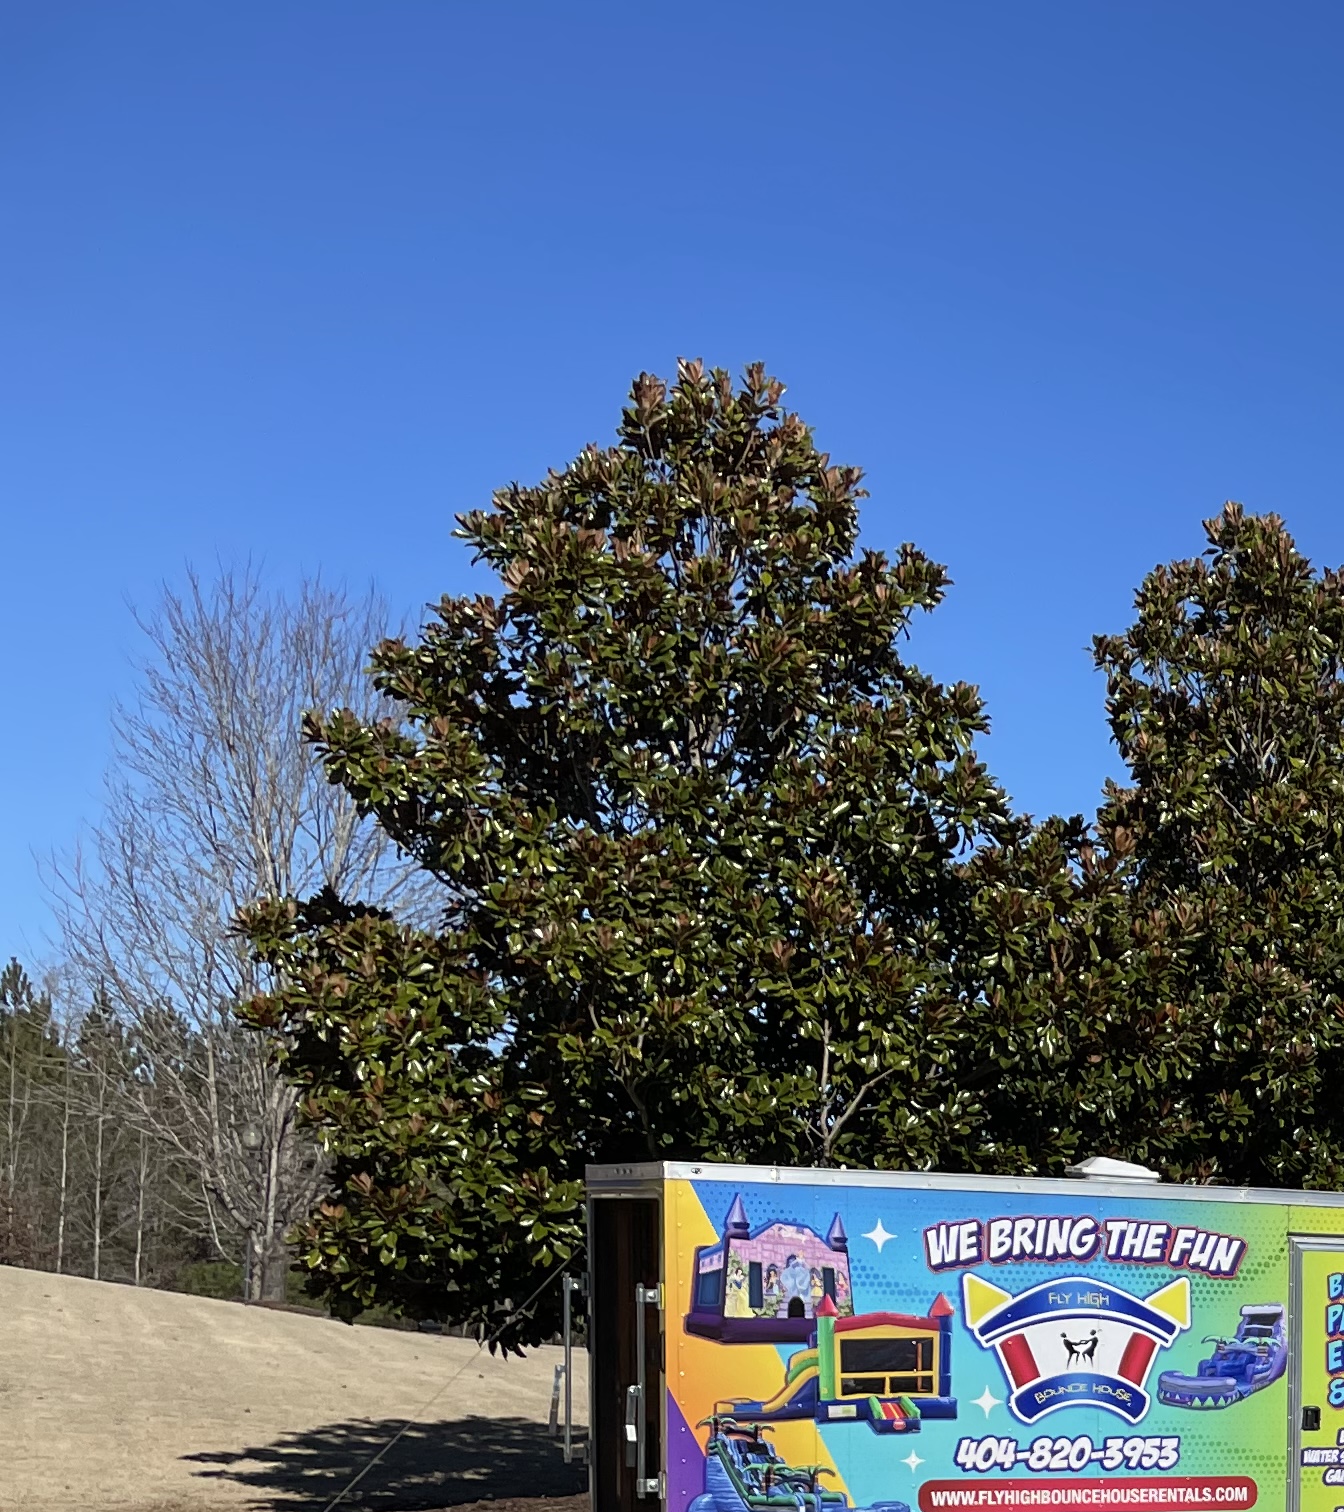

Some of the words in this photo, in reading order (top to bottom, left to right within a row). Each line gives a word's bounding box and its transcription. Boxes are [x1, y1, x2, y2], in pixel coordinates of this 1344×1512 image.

[926, 1221, 981, 1266] WE
[988, 1217, 1099, 1260] BRING
[1104, 1220, 1171, 1260] THE
[1170, 1227, 1242, 1272] FUN
[1048, 1292, 1073, 1305] FLY
[1077, 1291, 1110, 1307] HIGH
[1034, 1382, 1089, 1404] BOUNCE
[1092, 1382, 1133, 1402] HOUSE
[957, 1436, 1181, 1471] 404-820-3953
[1303, 1448, 1339, 1463] WATER
[931, 1486, 1248, 1507] WWW.FLYHIGHBOUNCEHOUSERENTALS.COM
